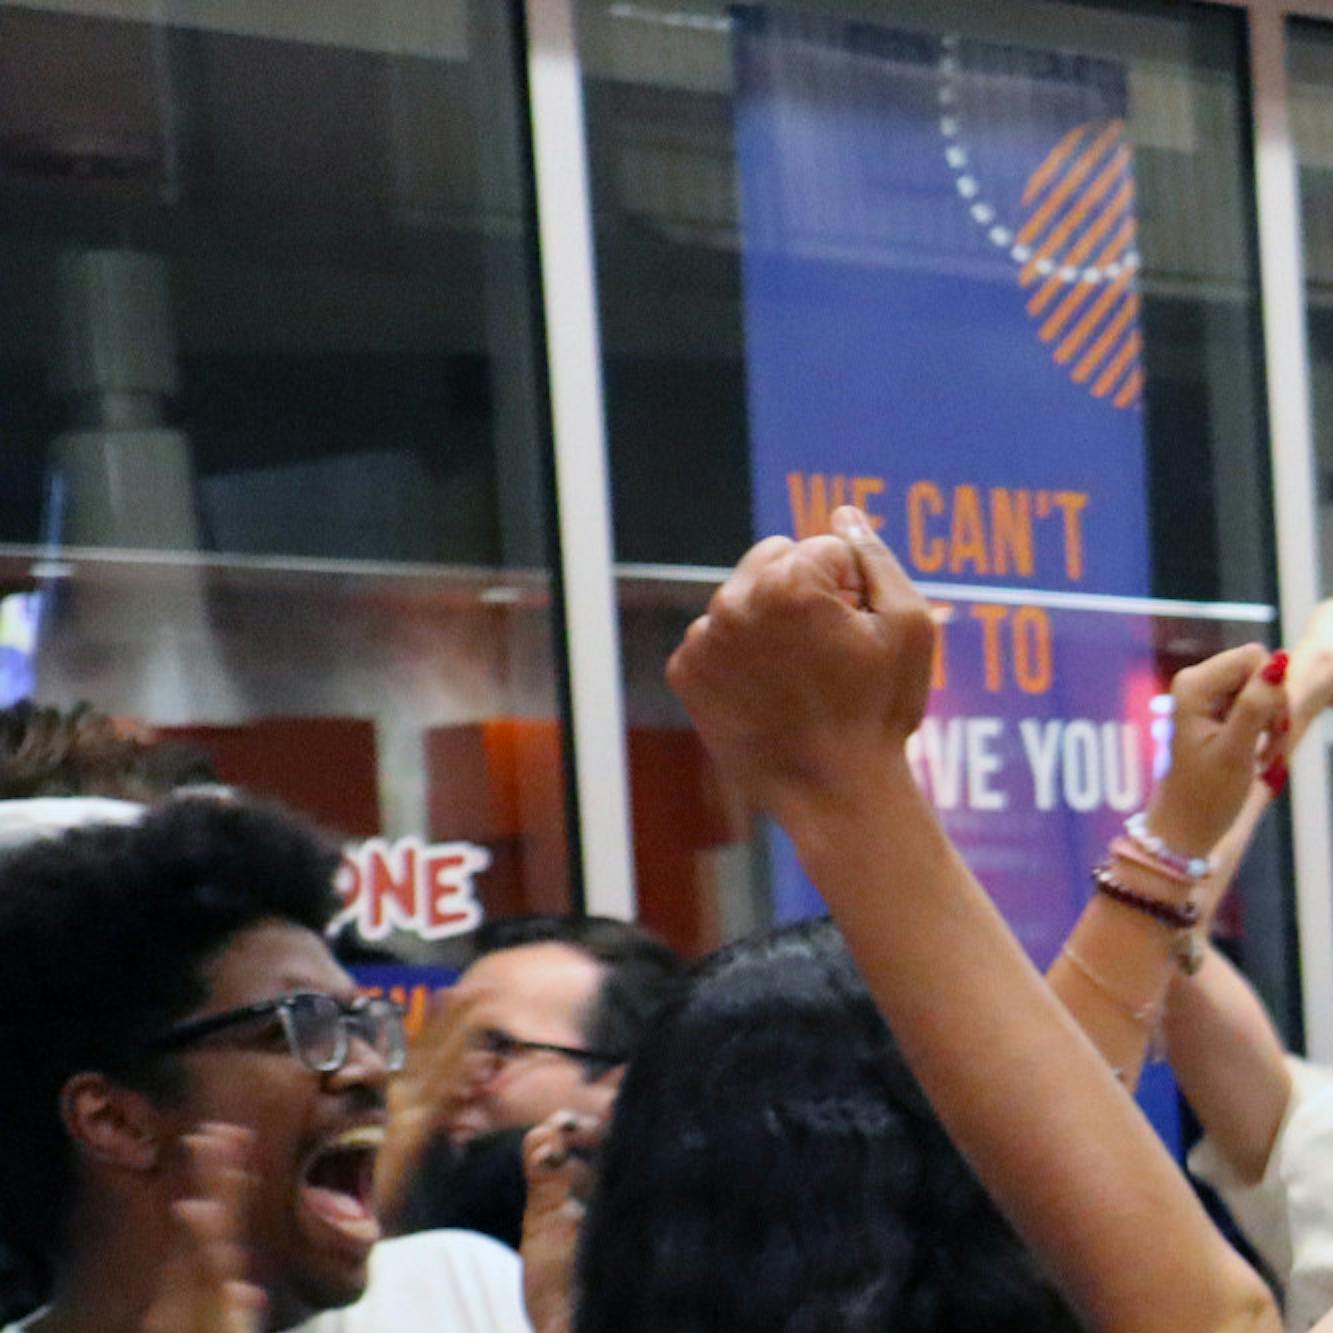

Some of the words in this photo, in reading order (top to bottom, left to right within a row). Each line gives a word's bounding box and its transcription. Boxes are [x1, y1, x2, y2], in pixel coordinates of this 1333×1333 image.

[906, 480, 1089, 581] CAN'T
[969, 604, 1054, 695] TO
[1020, 717, 1142, 813] YOU
